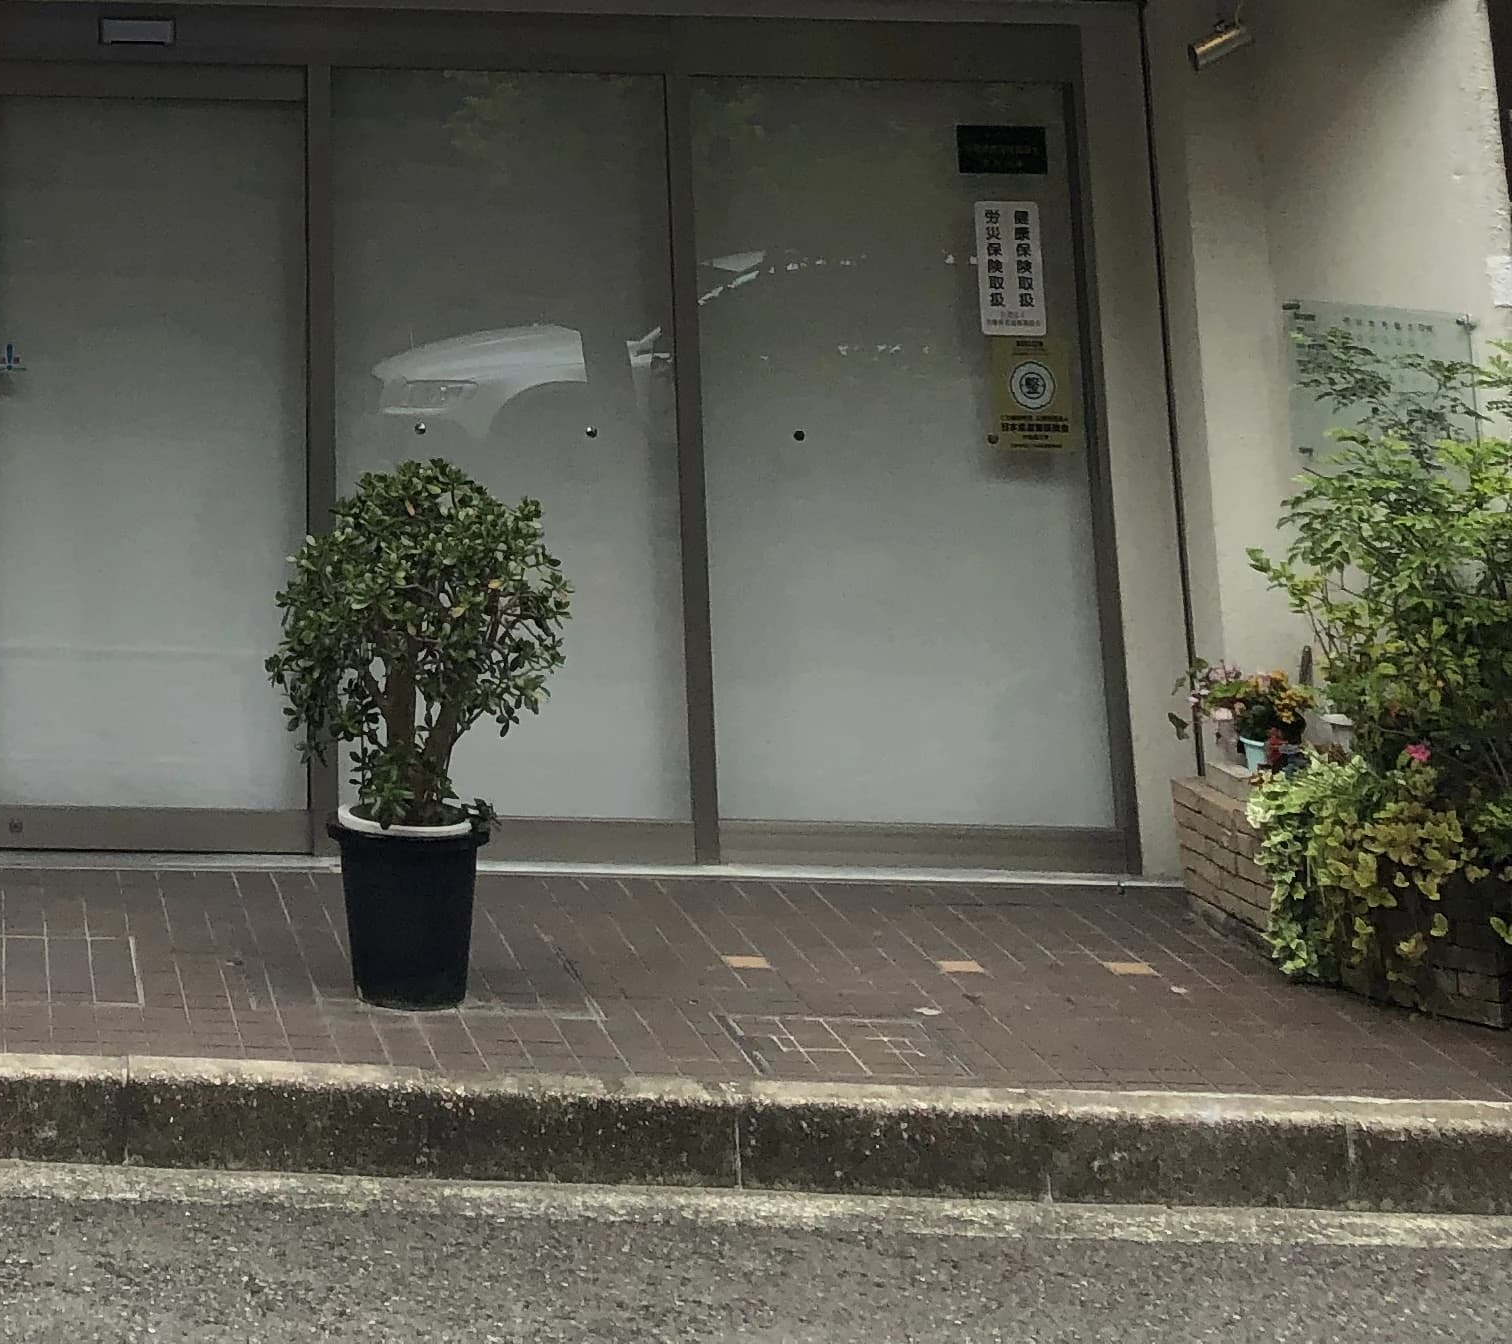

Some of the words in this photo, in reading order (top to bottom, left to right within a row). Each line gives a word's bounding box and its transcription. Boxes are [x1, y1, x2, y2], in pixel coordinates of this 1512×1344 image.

[984, 209, 1006, 308] 労災保険取扱
